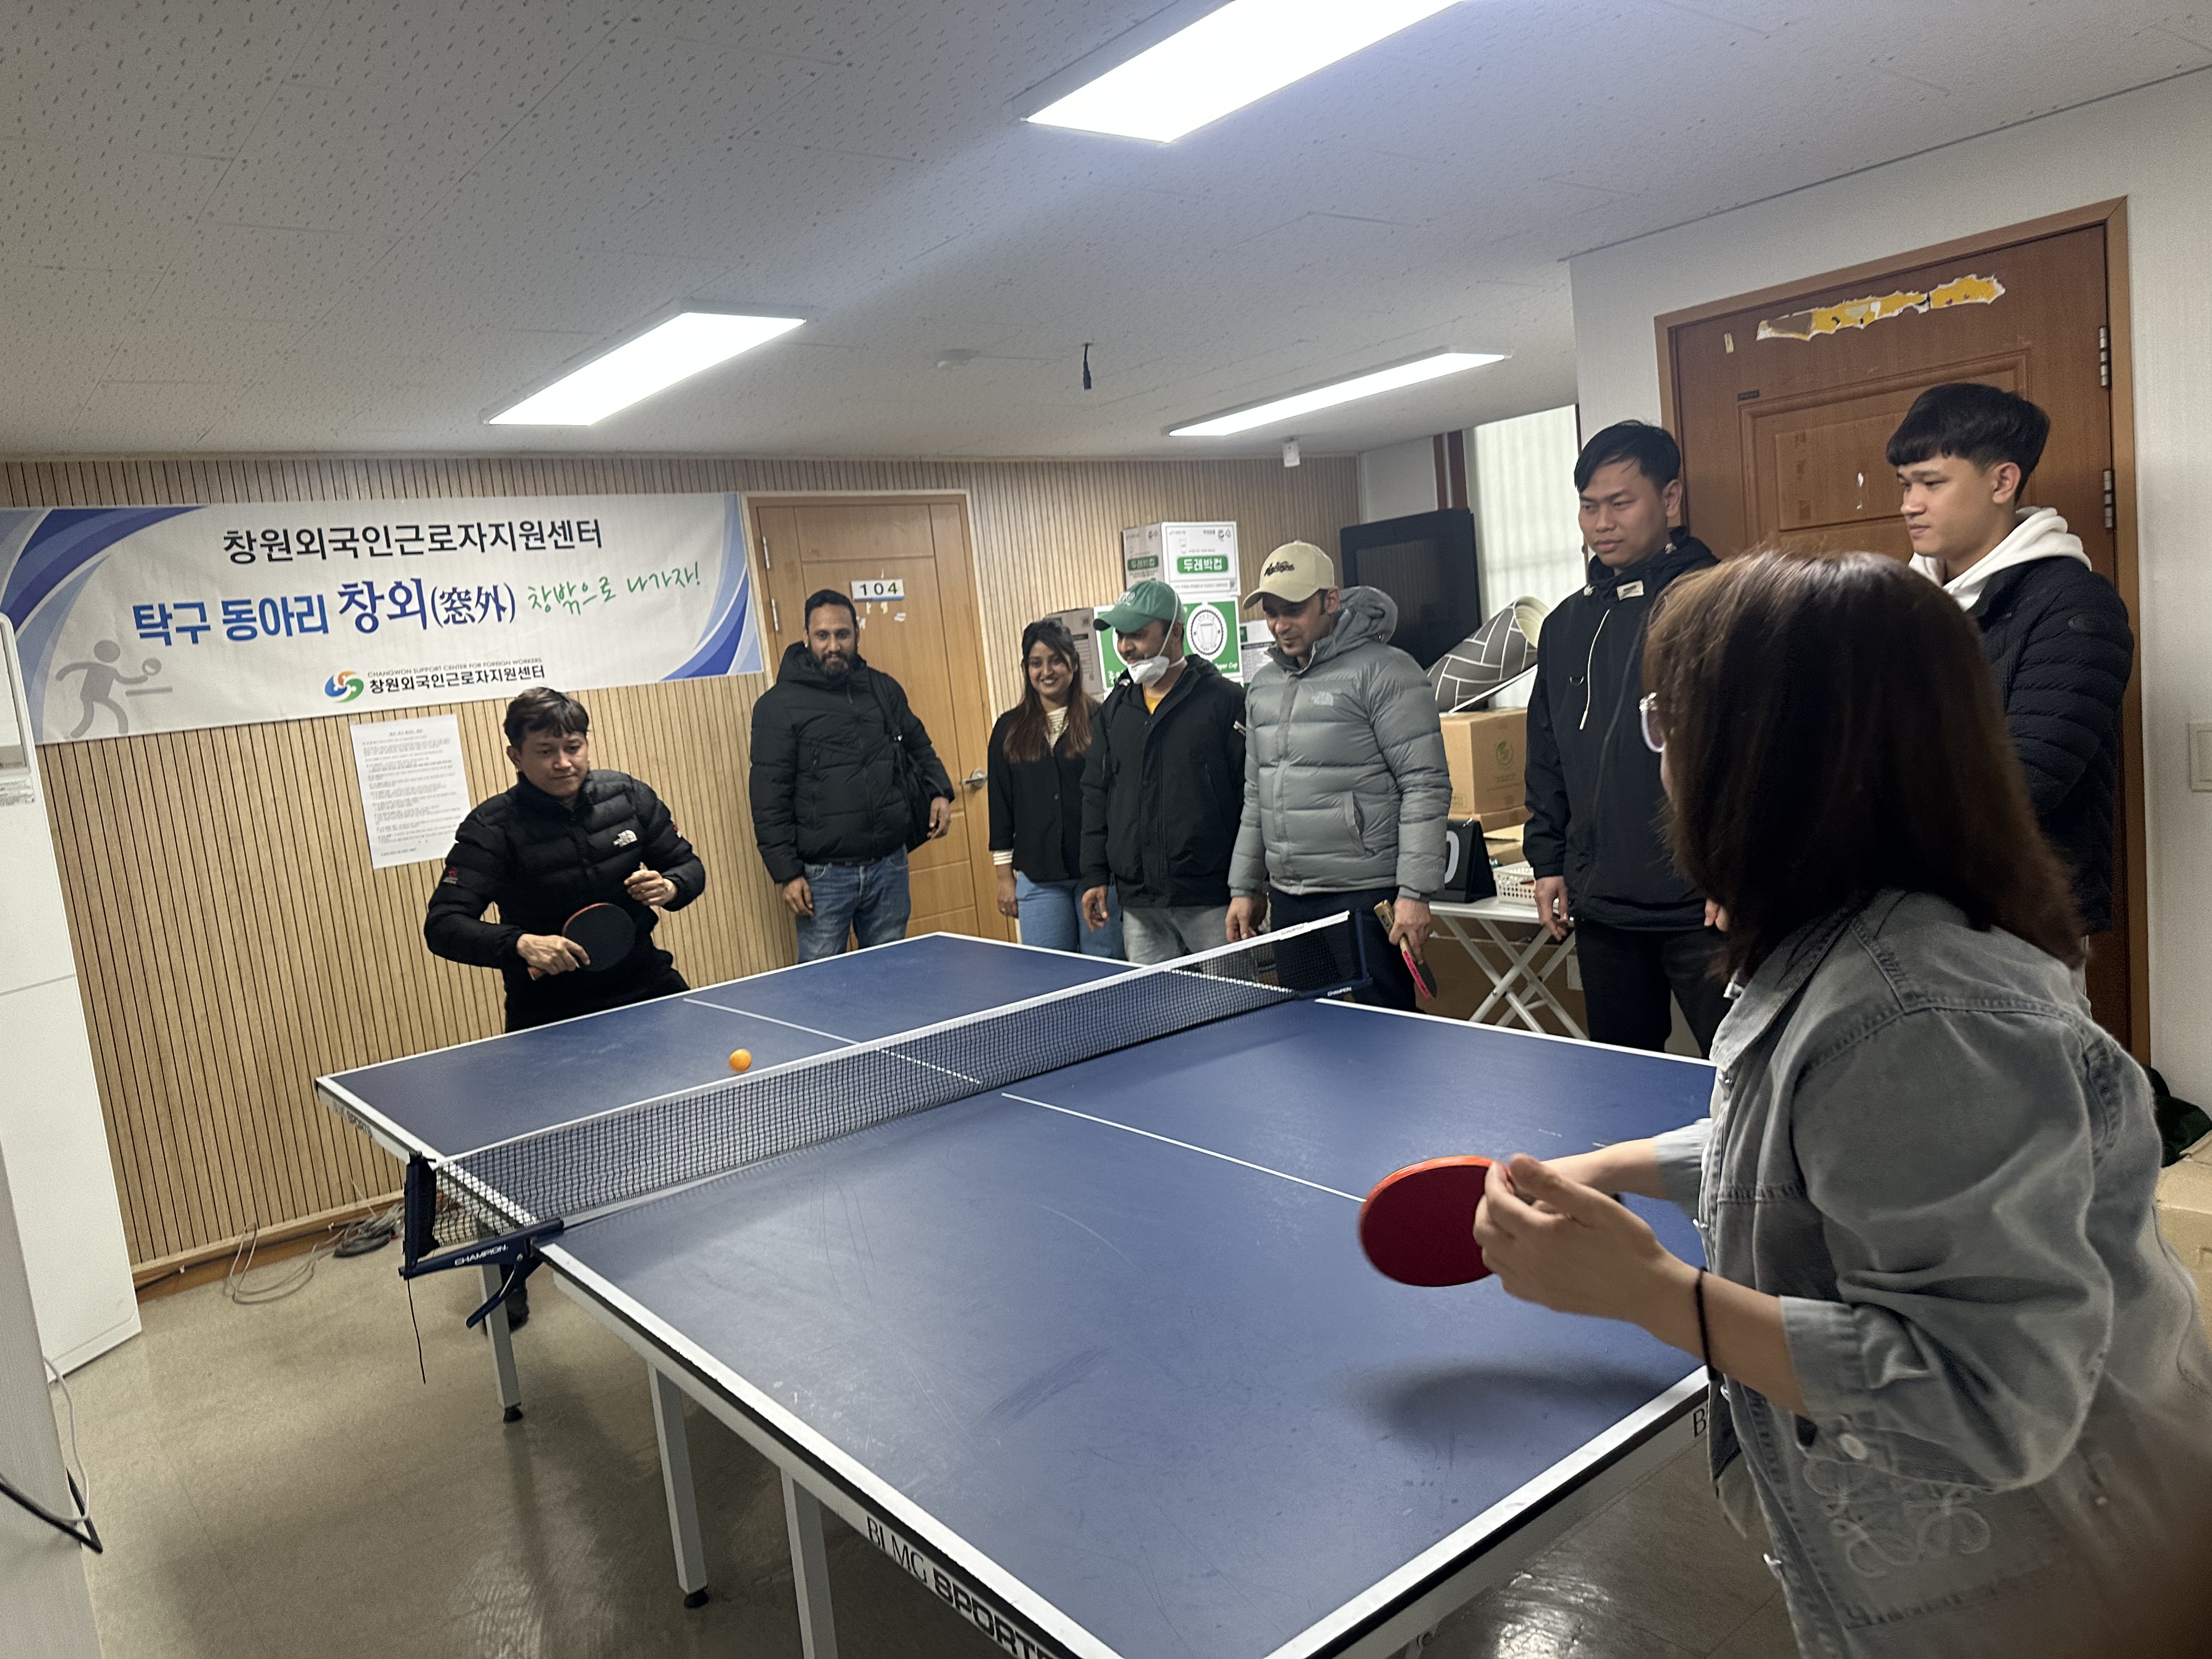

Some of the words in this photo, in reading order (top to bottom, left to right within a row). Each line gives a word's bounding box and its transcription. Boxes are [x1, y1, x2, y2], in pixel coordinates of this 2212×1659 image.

[224, 519, 602, 564] 창원외국인근로자지원센터
[860, 582, 898, 596] 104
[133, 601, 211, 646] 탁구
[221, 594, 329, 641] 동아리
[528, 576, 617, 615] 창밖으로
[627, 561, 701, 593] 나가자!
[368, 668, 411, 678] CHANGWON
[413, 665, 441, 674] SUPPORT
[443, 663, 467, 671] CENTER
[370, 665, 545, 693] 창원외국인근로자지원센터
[454, 1244, 506, 1266] CHAMPION
